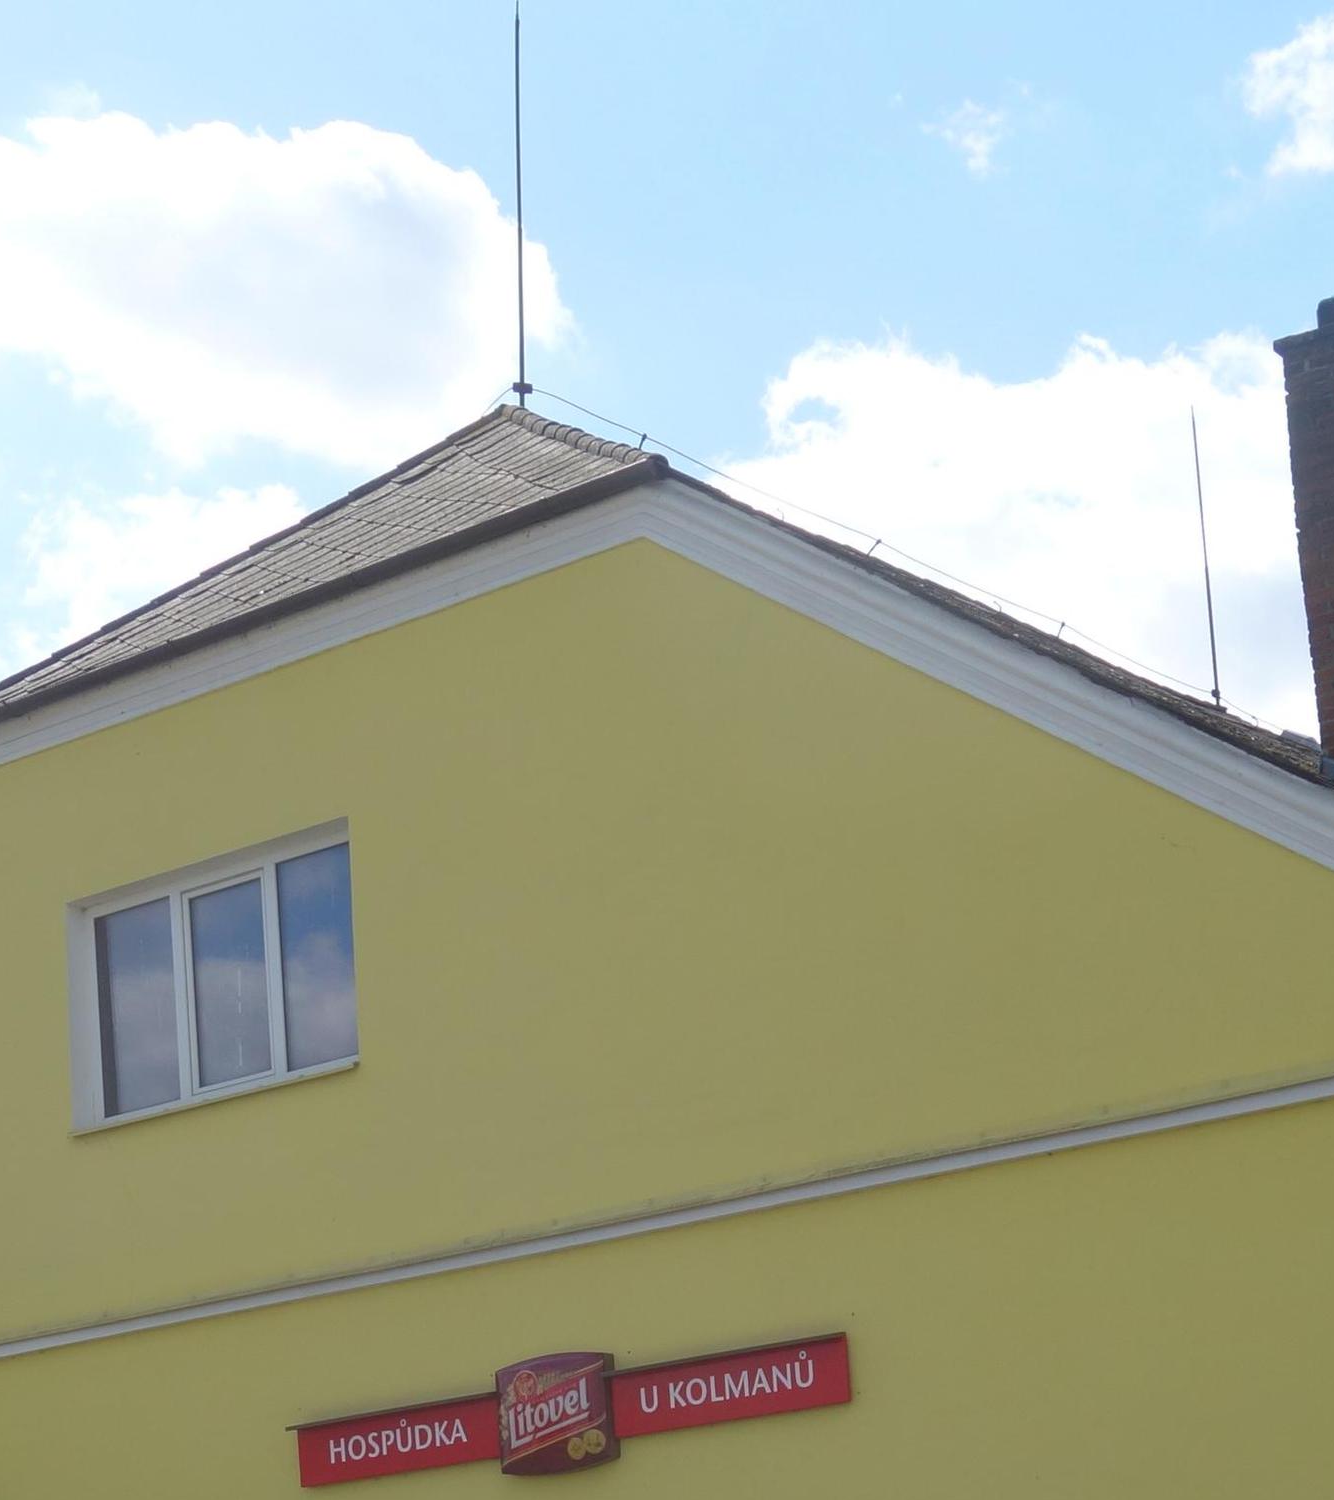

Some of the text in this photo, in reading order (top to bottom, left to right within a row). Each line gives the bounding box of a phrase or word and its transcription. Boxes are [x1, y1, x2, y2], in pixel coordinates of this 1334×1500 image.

[508, 1376, 591, 1450] Litovel
[640, 1350, 815, 1413] U KOLMANŮ
[329, 1418, 468, 1464] HOSPŮDKA
